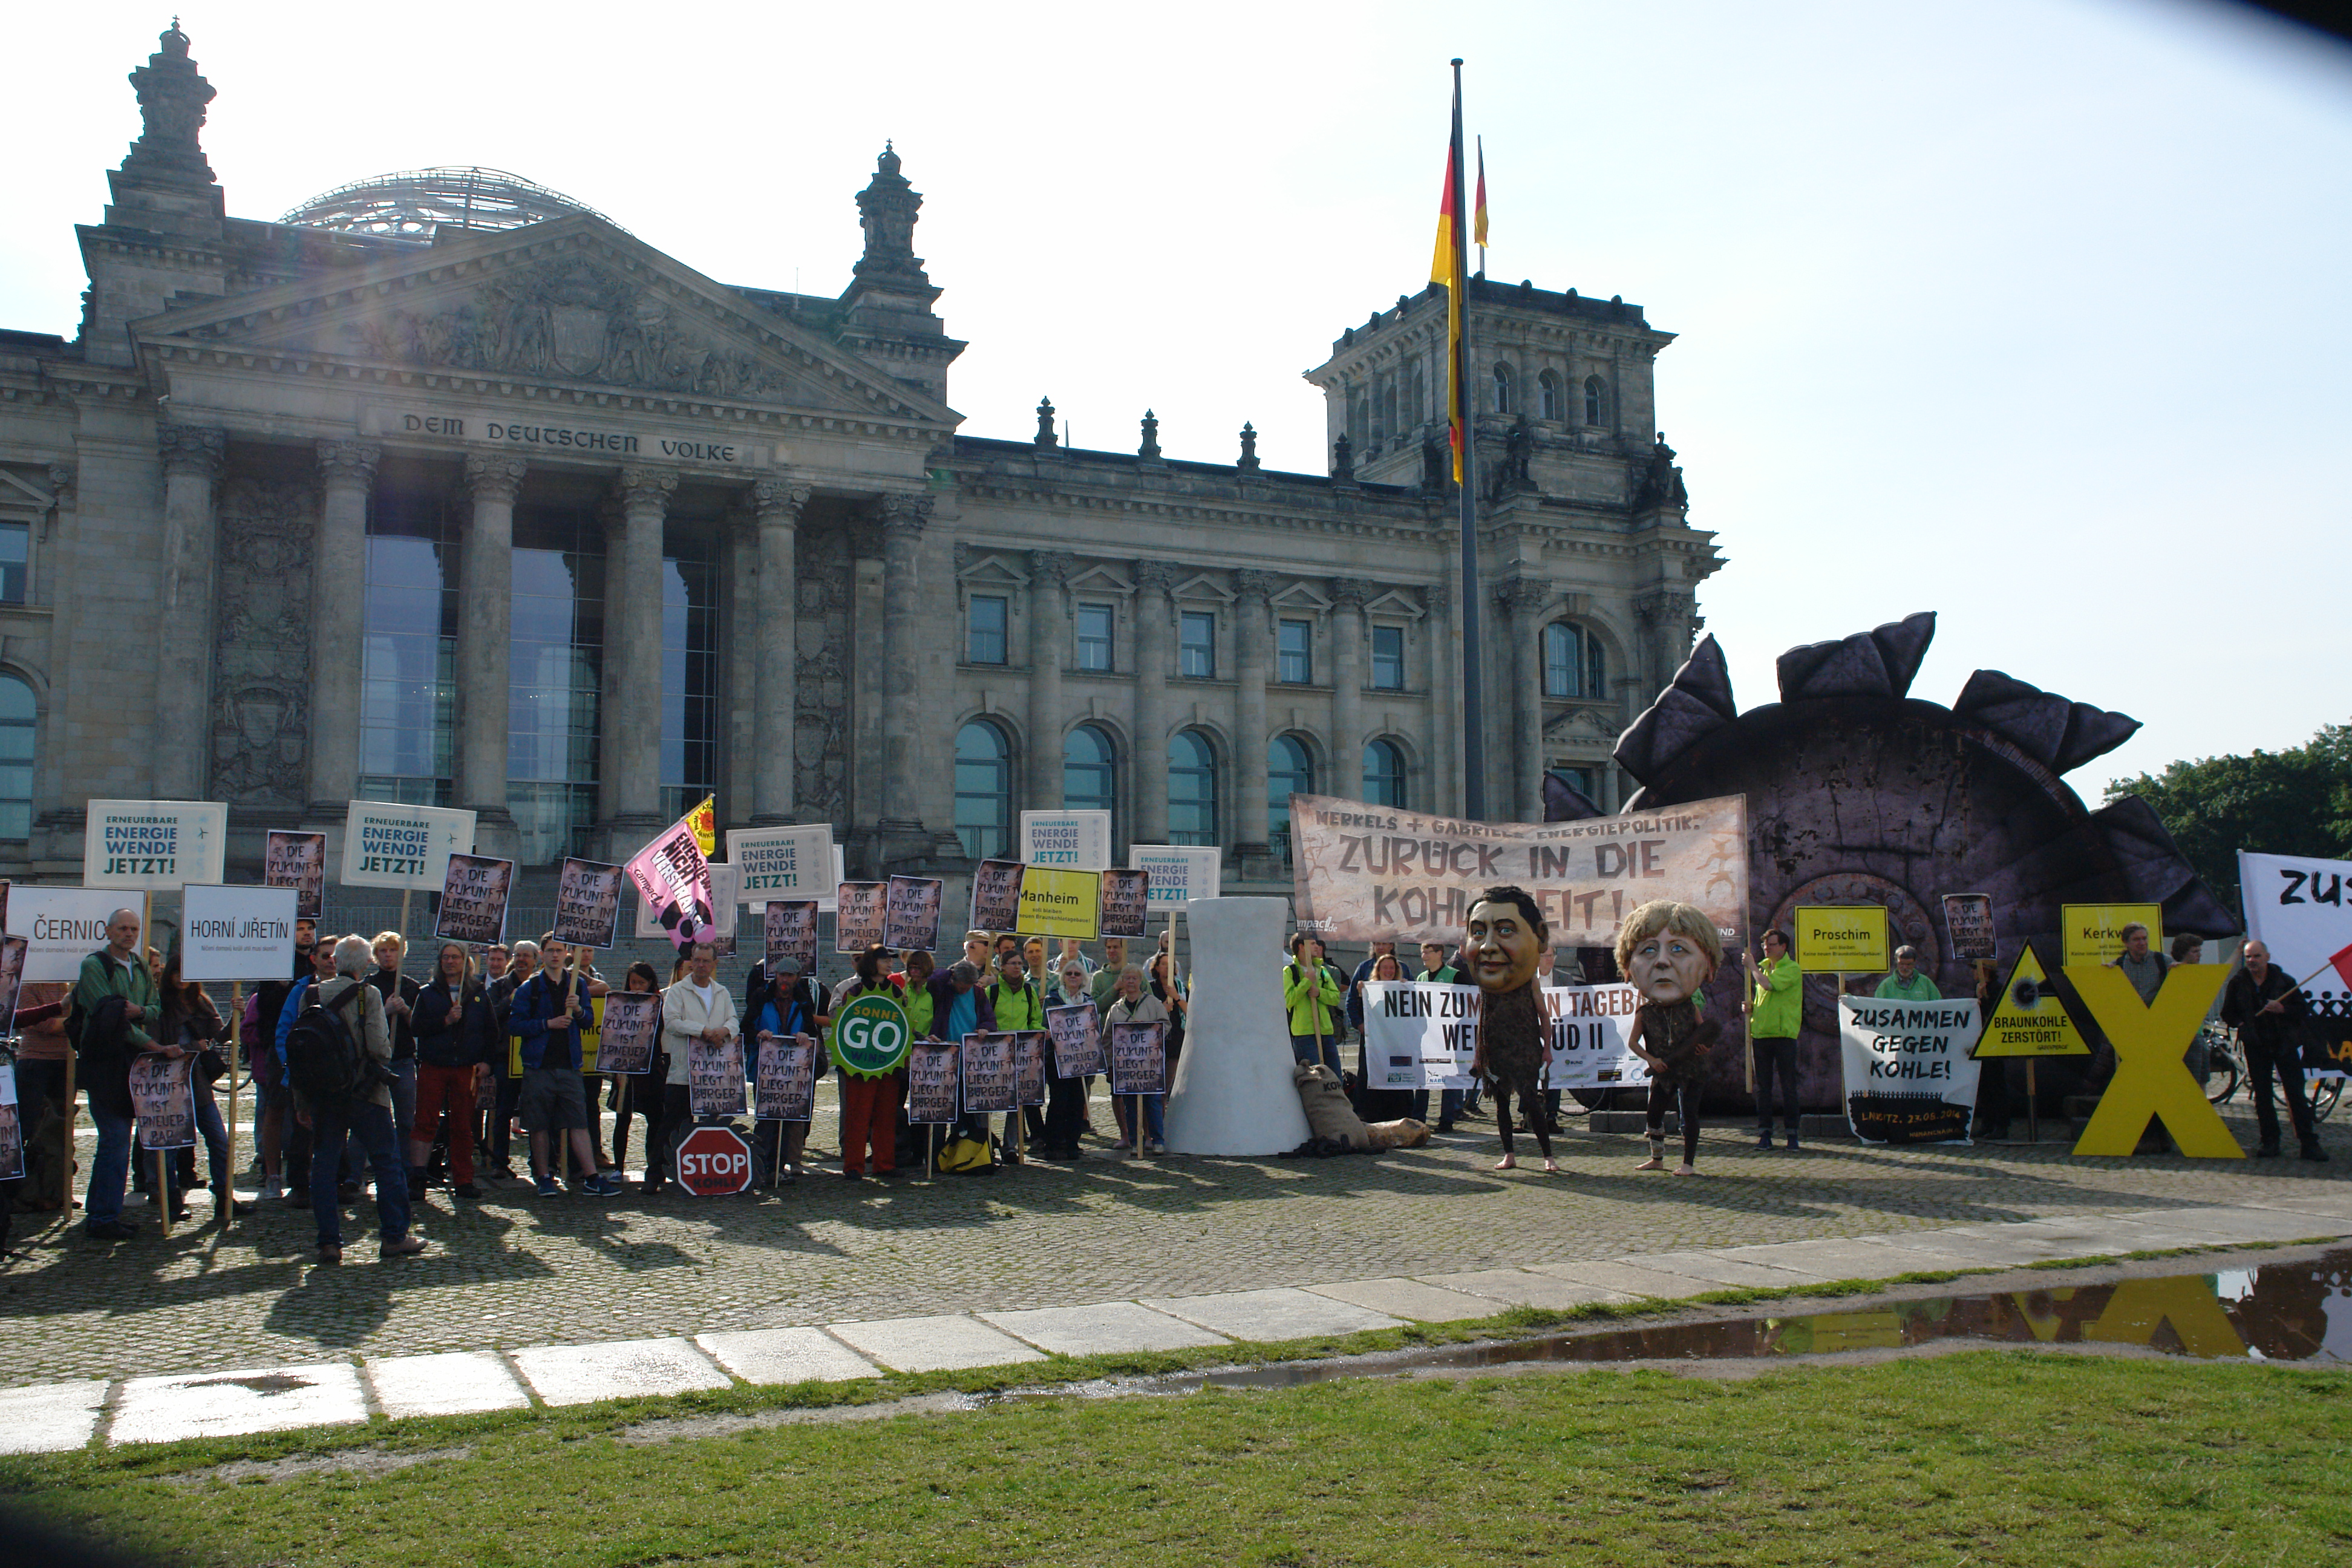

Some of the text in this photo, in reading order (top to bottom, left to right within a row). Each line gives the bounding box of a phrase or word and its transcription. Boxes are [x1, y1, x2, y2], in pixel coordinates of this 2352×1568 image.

[405, 414, 735, 462] DEM DEUTSCHEN VOLKE
[364, 817, 430, 829] ERNEUERBARE
[1315, 809, 1398, 831] MERKELS
[105, 826, 177, 839] ENERGIE
[362, 827, 429, 843] ENERGIE
[1031, 828, 1079, 838] ENERGIE
[105, 841, 177, 854] WENDE
[362, 840, 427, 857] WENDE
[740, 839, 796, 848] ERNEUERBARE
[1032, 839, 1079, 849] WENDE
[286, 845, 305, 858] DIE
[741, 848, 797, 861] ENERGIE
[1031, 851, 1079, 863] JETZT!
[1337, 834, 1666, 879] ZURÜCK IN DIE
[103, 858, 175, 874] JETZT!
[270, 860, 319, 874] ZUKUNFT
[359, 856, 425, 875] JETZT!
[742, 860, 797, 874] WENDE
[468, 869, 489, 883] DIE
[581, 874, 601, 887] DIE
[743, 874, 799, 890] JETZT!
[993, 871, 1008, 881] DIE
[308, 877, 319, 888] IN
[1119, 879, 1134, 889] DIE
[2279, 869, 2352, 907] ZU
[447, 882, 503, 900] ZUKUNFT
[563, 886, 615, 904] ZUKUNFT
[907, 888, 924, 899] DIE
[978, 883, 1018, 895] ZUKUNFT
[1148, 887, 1187, 900] ETZT!
[855, 892, 871, 903] DIE
[990, 897, 1009, 906] IST
[1105, 891, 1147, 901] ZUKUNFT
[444, 897, 500, 915] LIEGT IN
[560, 901, 611, 918] LIEGT IN
[840, 906, 883, 915] ZUKUNFT
[890, 900, 936, 913] ZUKUNFT
[1105, 903, 1144, 913] LIEGT IN
[783, 912, 800, 923] DIE
[854, 918, 869, 927] IST
[905, 914, 921, 924] IST
[34, 913, 111, 941] ČERNIC
[191, 916, 289, 939] HORNÍ JIŘETÍN
[768, 926, 814, 937] ZUKUNFT
[1813, 929, 1871, 940] Proschim
[768, 940, 812, 952] LIEGT IN
[901, 936, 921, 946] BAR
[1383, 990, 1432, 1018] NEIN
[623, 1005, 641, 1016] DIE
[852, 1005, 900, 1022] SONNE
[605, 1018, 653, 1031] ZUKUNFT
[1065, 1016, 1082, 1028] DIE
[1851, 1008, 1970, 1030] ZUSAMMEN
[1994, 1016, 2068, 1028] BRAUNKOHLE
[619, 1033, 636, 1044] IST
[843, 1016, 902, 1053] GO
[1054, 1028, 1096, 1042] ZUKUNFT
[1130, 1033, 1146, 1044] DIE
[2001, 1028, 2061, 1044] ZERSTÖRT!
[1070, 1042, 1085, 1052] IST
[1872, 1034, 1949, 1054] GEGEN
[778, 1050, 796, 1062] DIE
[851, 1050, 887, 1065] WIND
[981, 1046, 998, 1057] DIE
[1116, 1046, 1159, 1057] ZUKUNFT
[691, 1060, 739, 1071] ZUKUNFT
[927, 1056, 942, 1067] DIE
[967, 1059, 1011, 1071] ZUKUNFT
[1117, 1059, 1159, 1070] LIEGT IN
[151, 1064, 172, 1077] DIE
[760, 1064, 809, 1077] ZUKUNFT
[912, 1070, 954, 1081] ZUKUNFT
[1869, 1060, 1950, 1080] KOHLE!
[693, 1075, 739, 1086] LIEGT IN
[761, 1079, 808, 1091] LIEGT IN
[968, 1074, 998, 1085] LIEGT
[1002, 1074, 1012, 1083] IN
[131, 1081, 185, 1096] ZUKUNFT
[912, 1085, 953, 1095] LIEGT IN
[152, 1100, 169, 1112] IST
[682, 1152, 747, 1175] STOP
[693, 1177, 738, 1188] KOHLE
